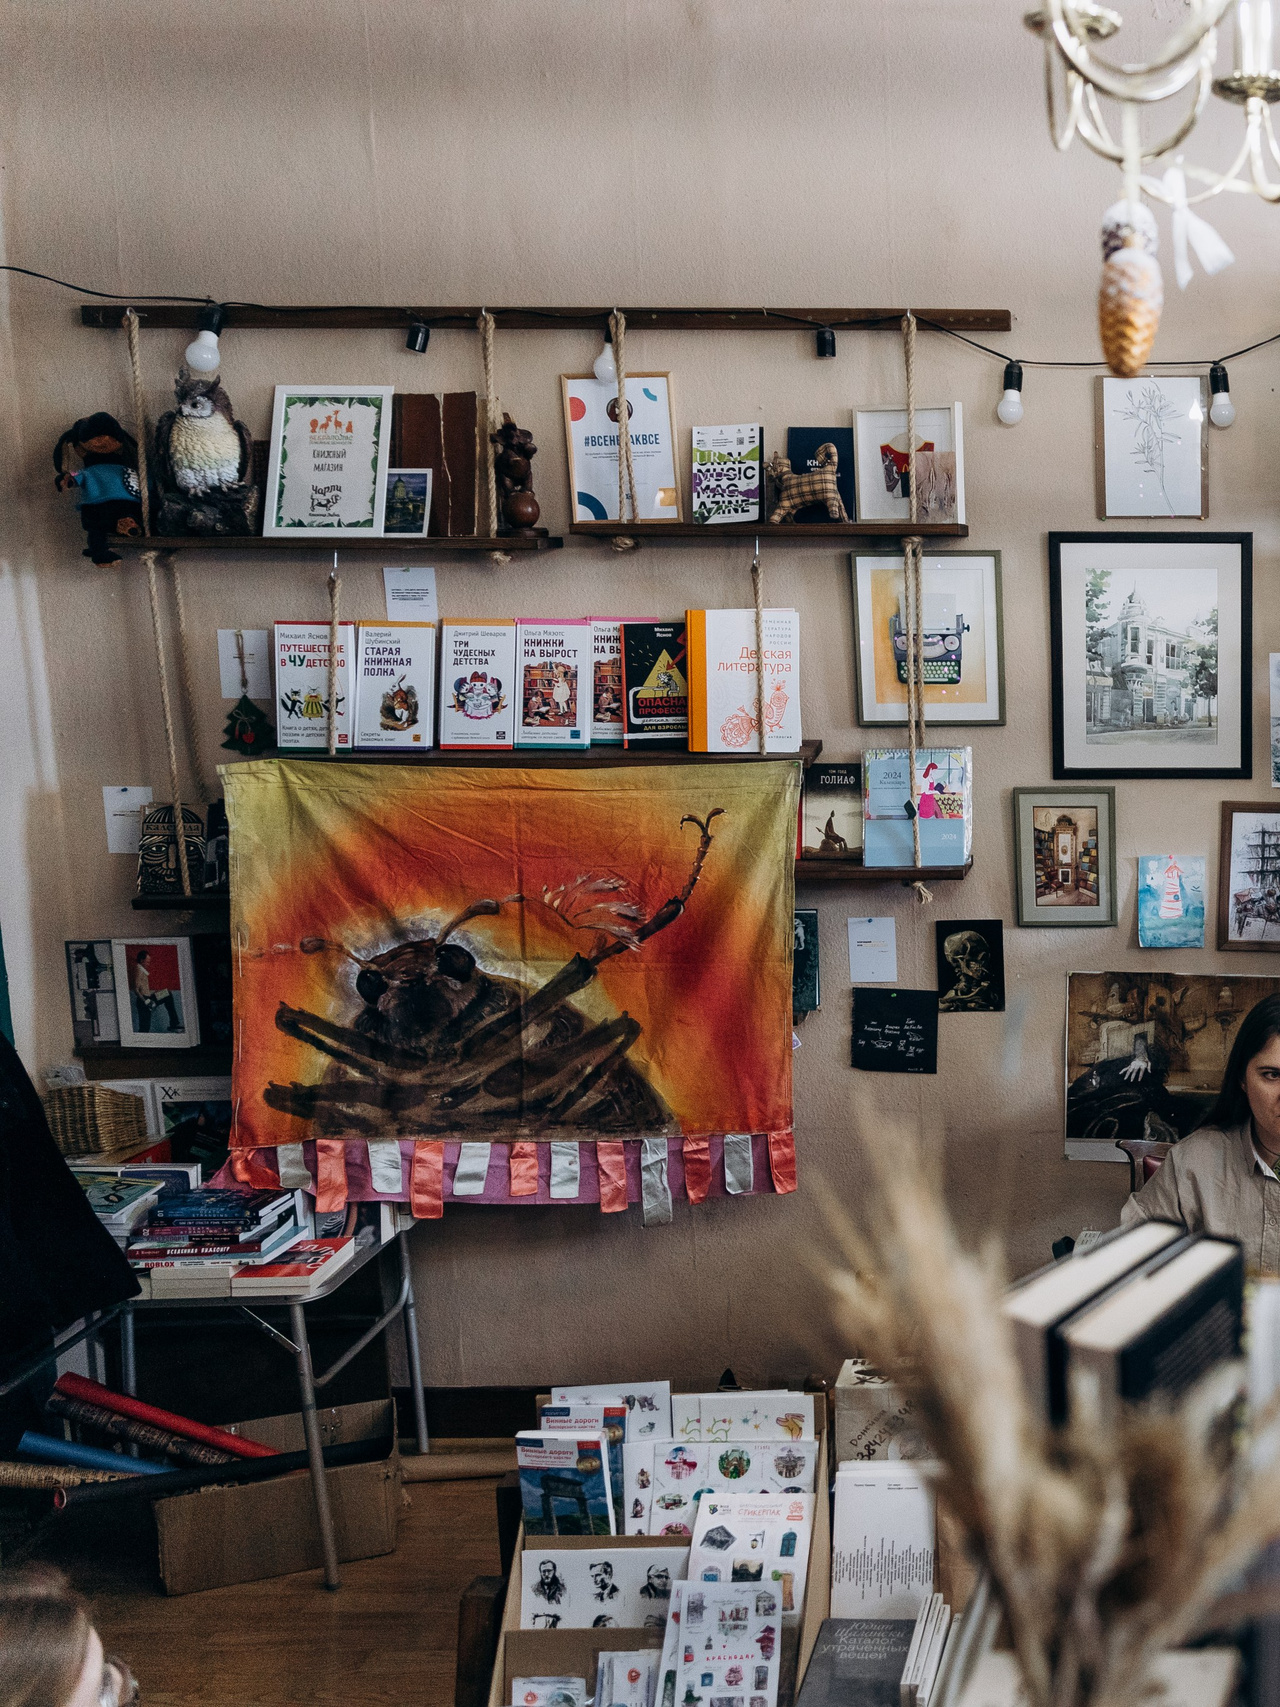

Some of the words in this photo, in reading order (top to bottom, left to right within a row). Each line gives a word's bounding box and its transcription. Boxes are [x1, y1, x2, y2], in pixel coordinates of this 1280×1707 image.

[523, 638, 564, 648] КНИЖКИ
[364, 646, 401, 656] СТАРАЯ
[453, 649, 496, 657] ЧУДЕСНЫХ
[523, 649, 536, 658] НА
[540, 649, 578, 658] ВЫРОСТ
[364, 657, 412, 667] КНИЖНАЯ
[453, 658, 489, 666] ДЕТСТВА
[363, 667, 396, 677] ПОЛКА
[820, 775, 856, 785] ГОЛИАФ
[883, 771, 902, 780] 2024
